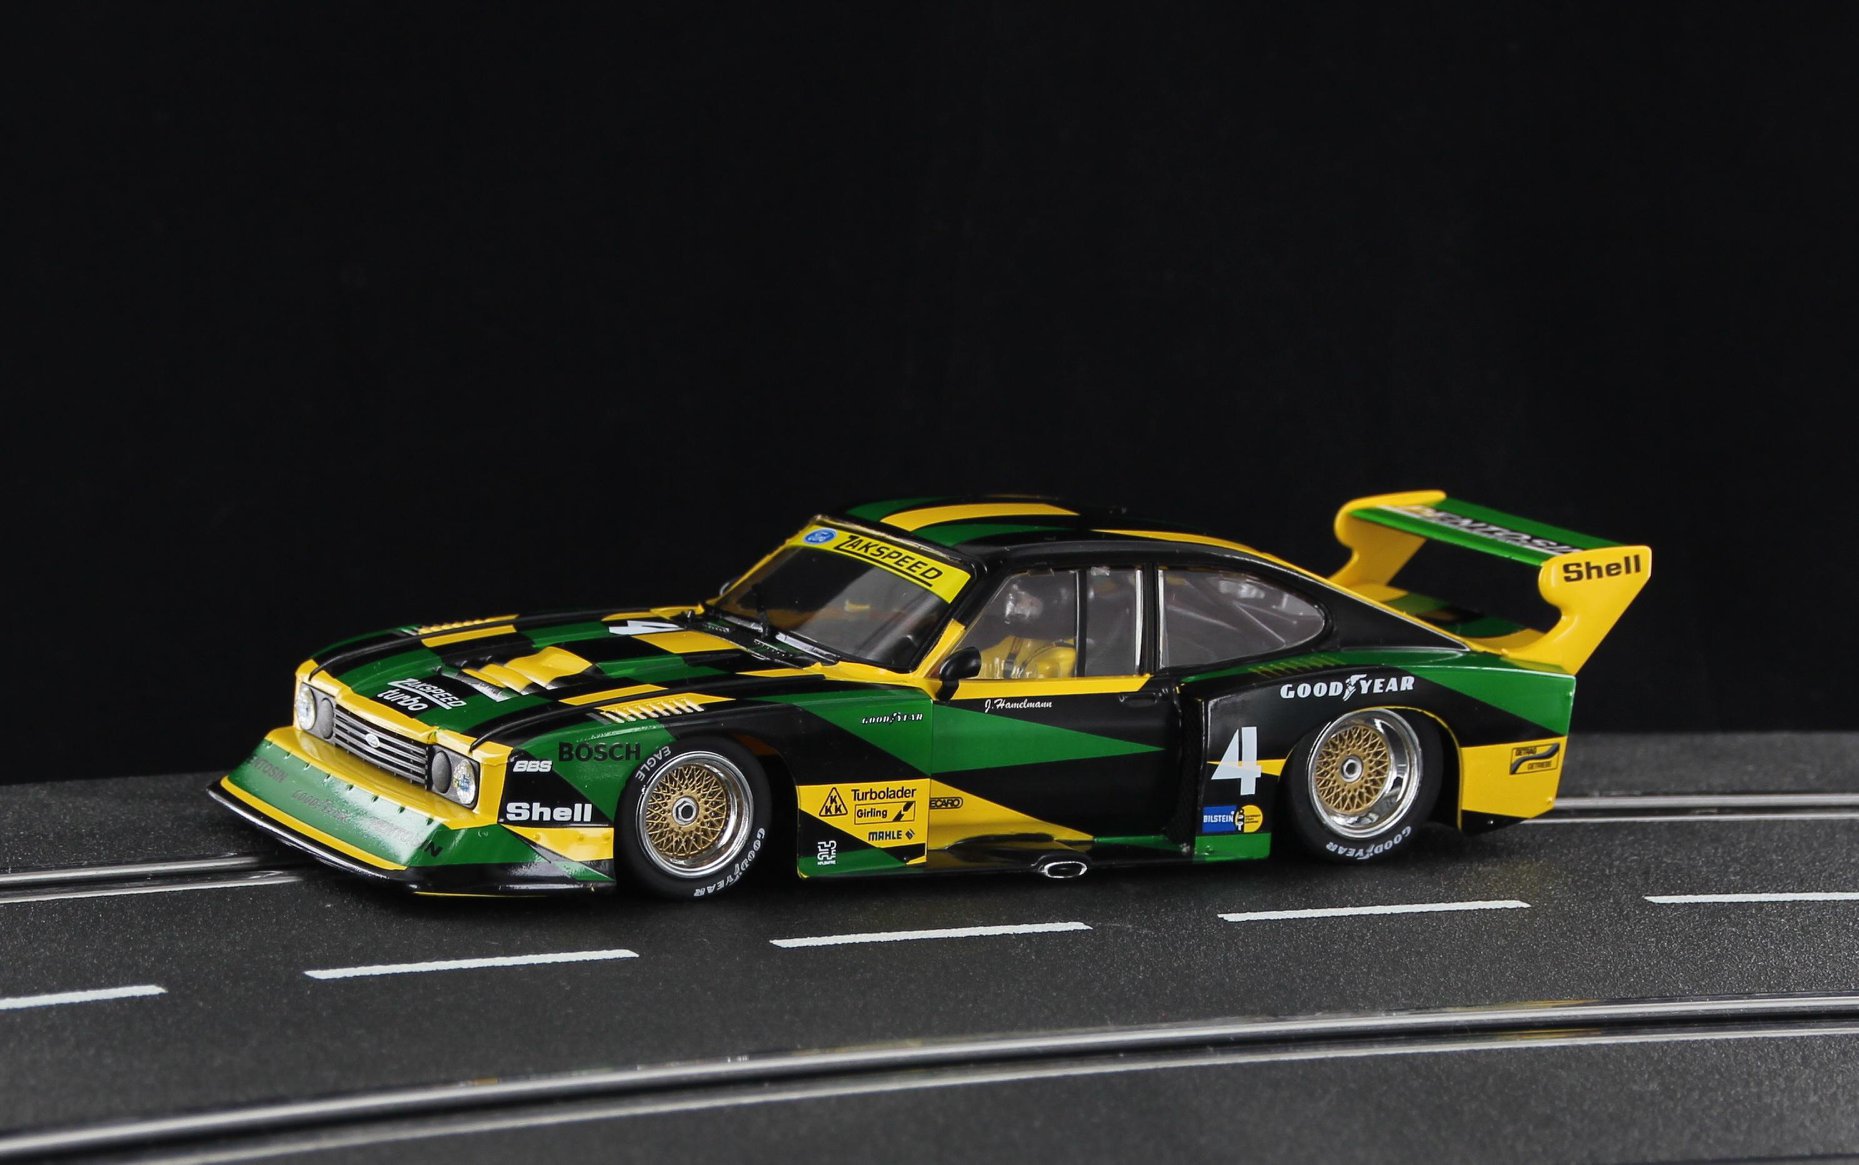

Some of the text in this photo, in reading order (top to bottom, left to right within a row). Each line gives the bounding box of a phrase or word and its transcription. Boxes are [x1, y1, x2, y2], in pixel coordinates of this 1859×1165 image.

[834, 535, 944, 587] ZAKSPEED
[1563, 555, 1641, 582] Shell
[377, 689, 428, 711] turbo
[558, 742, 641, 762] BOSCH
[1211, 726, 1262, 796] 4
[513, 760, 552, 773] BBS
[635, 745, 672, 782] EAGLE
[851, 786, 917, 802] Turbolader
[930, 798, 961, 808] ECARO
[506, 802, 593, 822] Shell
[856, 808, 888, 818] Girling
[1203, 814, 1234, 823] BILSTEIN
[868, 830, 902, 841] MAHLE
